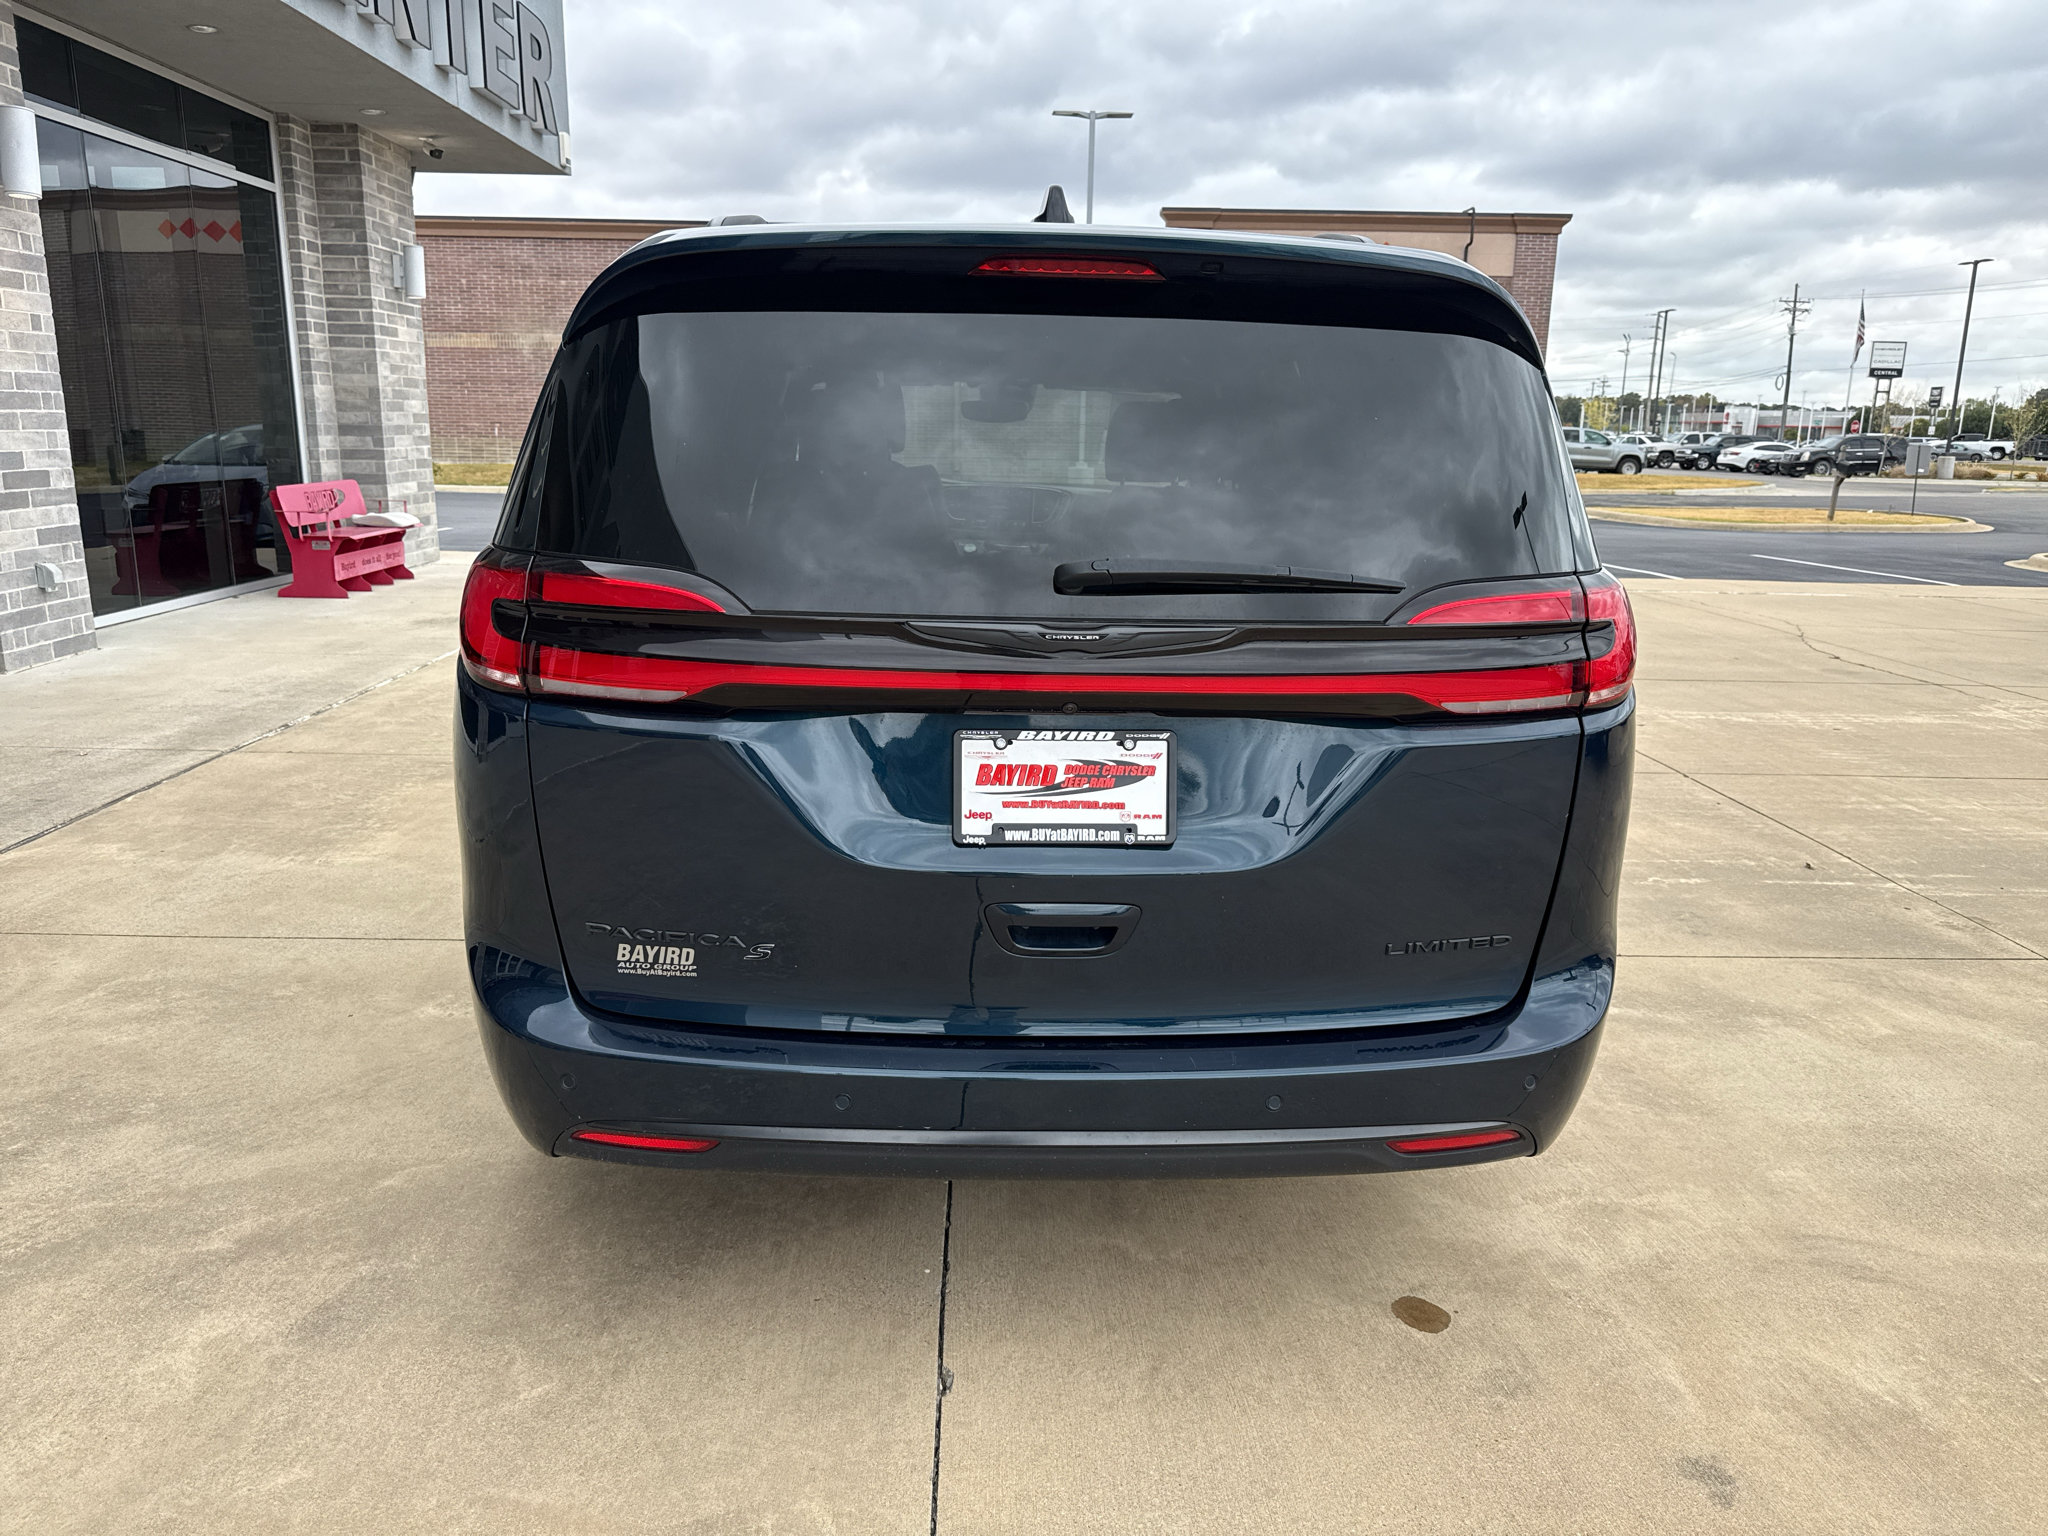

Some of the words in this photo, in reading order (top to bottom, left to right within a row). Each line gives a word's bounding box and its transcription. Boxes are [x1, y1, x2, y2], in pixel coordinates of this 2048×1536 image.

[1016, 730, 1115, 741] BAYIRD
[975, 763, 1058, 787] BAYIRD
[1064, 764, 1101, 775] DODGE
[1102, 765, 1156, 777] CHRYSLER
[1061, 776, 1088, 788] JEEP
[1089, 777, 1115, 788] RAM
[1002, 800, 1125, 810] www.BUYatBAYIRD.com
[964, 809, 993, 821] Jeep
[962, 834, 986, 846] Jeep
[1004, 828, 1120, 842] www.BUYatBAYIRD.com
[585, 922, 746, 948] PACIFICA
[743, 943, 776, 960] S
[1385, 934, 1513, 955] LIMITED
[616, 943, 695, 966] BAYIRD
[617, 961, 650, 969] AUTO
[654, 963, 697, 971] GROUP
[617, 968, 698, 977] www.BuyAtBayird.com
